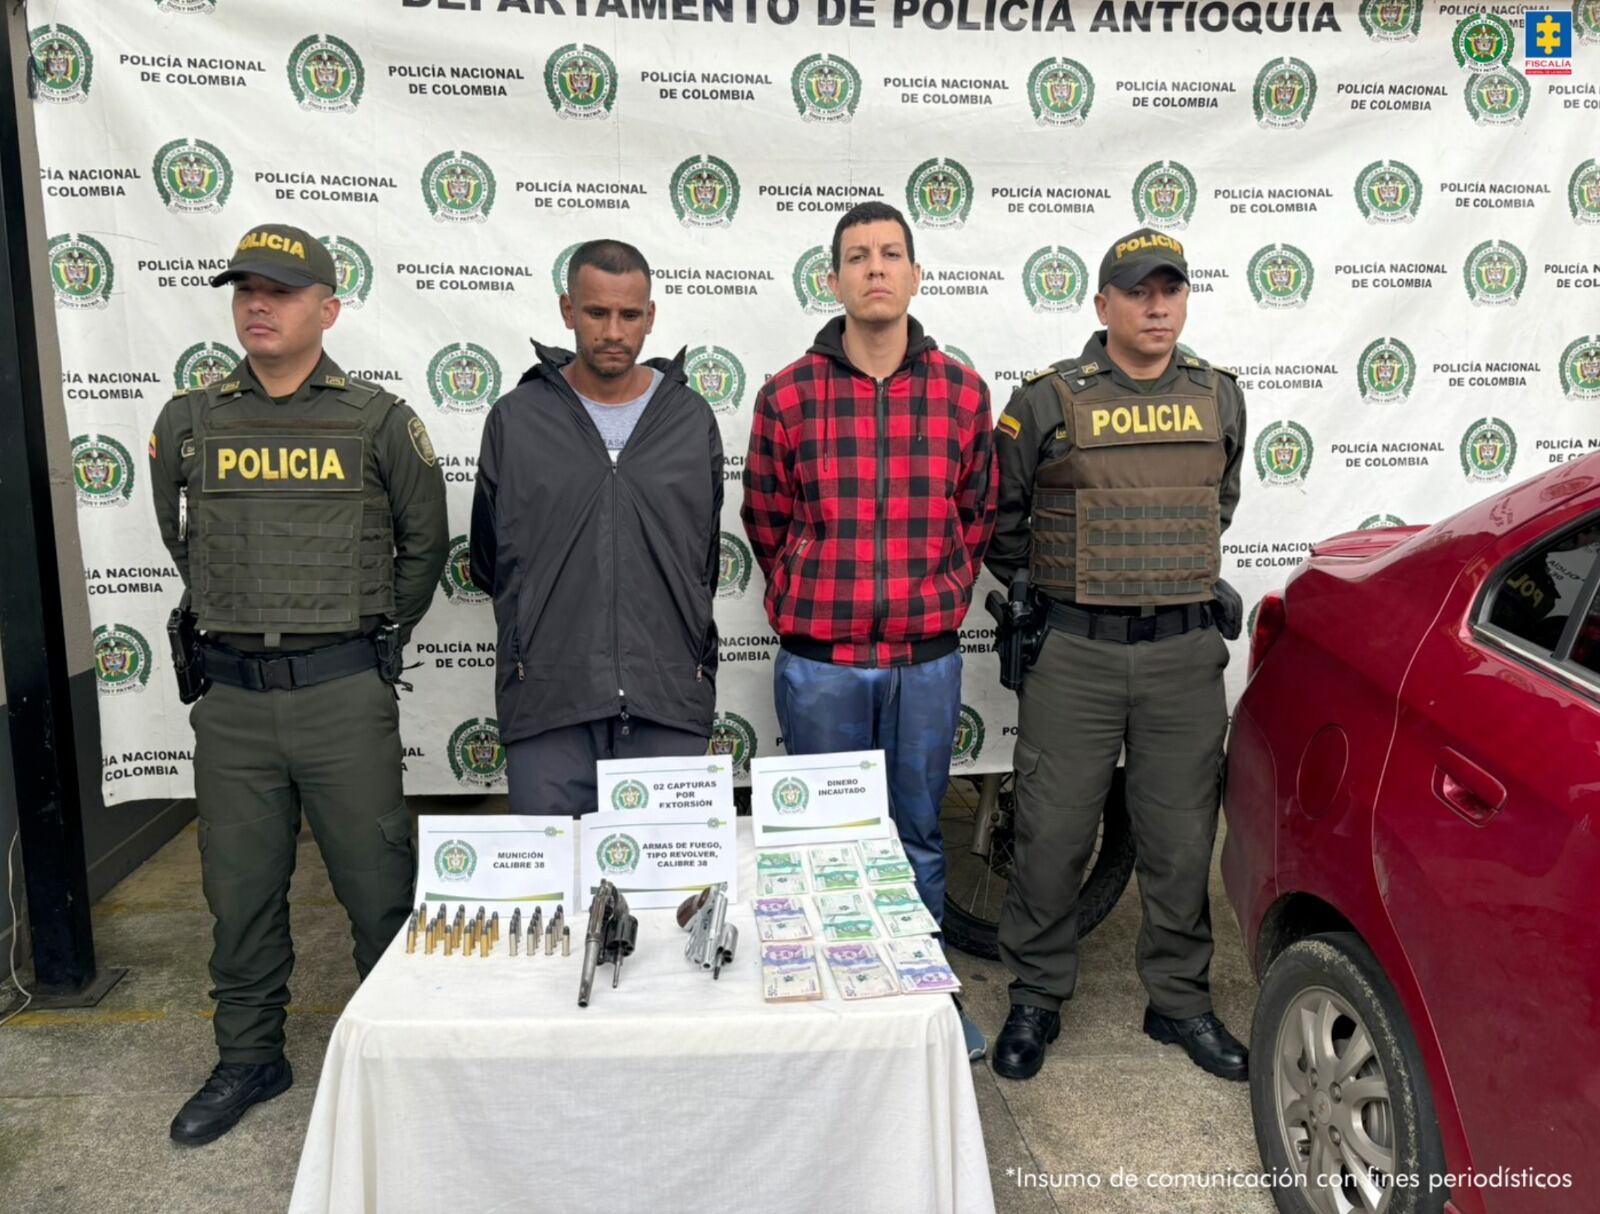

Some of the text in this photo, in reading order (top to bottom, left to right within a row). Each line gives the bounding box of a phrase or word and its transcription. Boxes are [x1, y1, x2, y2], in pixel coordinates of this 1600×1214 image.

[817, 0, 876, 28] DE
[1089, 1, 1342, 35] ANTIOQUIA
[120, 55, 265, 71] POLICÍA NACIONAL
[388, 65, 524, 79] POLICÍA NACIONAL
[641, 71, 772, 84] POLICÍA NACIONAL
[141, 72, 246, 86] DE COLOMBIA
[884, 77, 1008, 89] POLICÍA NACIONAL
[409, 84, 507, 96] DE COLOMBIA
[1116, 80, 1236, 92] POLICÍA NACIONAL
[1337, 83, 1448, 95] POLICÍA NACIONAL
[1548, 83, 1596, 95] POLICÍA
[660, 89, 754, 100] DE COLOMBIA
[902, 93, 992, 104] DE COLOMBIA
[1133, 97, 1218, 108] DE COLOMBIA
[1351, 100, 1431, 110] DE COLOMBIA
[1564, 99, 1580, 108] DE
[69, 168, 141, 180] NACIONAL
[255, 172, 397, 188] POLICÍA NACIONAL
[48, 186, 125, 197] COLOMBIA
[516, 181, 647, 194] POLICÍA NACIONAL
[759, 184, 884, 196] POLICÍA NACIONAL
[992, 186, 1111, 198] POLICÍA NACIONAL
[1441, 182, 1550, 193] POLICÍA NACIONAL
[276, 189, 379, 202] DE COLOMBIA
[1214, 188, 1333, 199] POLICÍA NACIONAL
[535, 198, 630, 209] DE COLOMBIA
[777, 202, 793, 211] DE
[1008, 203, 1094, 213] DE COLOMBIA
[1230, 203, 1317, 213] DE COLOMBIA
[1456, 198, 1534, 208] DE COLOMBIA
[1115, 233, 1183, 259] POLICIA
[138, 258, 230, 271] POLICÍA NACI
[397, 263, 532, 276] POLICÍA NACIONAL
[1335, 263, 1447, 274] POLICÍA NACIONAL
[1545, 264, 1588, 274] POLICÍA
[706, 270, 774, 280] NACIONAL
[939, 271, 1004, 280] NACIONAL
[1190, 270, 1229, 278] IONAL
[158, 277, 176, 287] DE
[416, 280, 514, 291] DE COLOMBIA
[1352, 278, 1432, 288] DE COLOMBIA
[1557, 279, 1570, 288] DE
[665, 285, 757, 295] DE COLOMBIA
[920, 285, 989, 296] COLOMBIA
[1275, 365, 1338, 374] NACIONAL
[1433, 362, 1540, 373] POLICÍA NACIONAL
[88, 373, 160, 383] NACIONAL
[349, 370, 403, 381] CIONAL
[1258, 379, 1323, 389] COLOMBIA
[1449, 377, 1526, 386] DE COLOMBIA
[67, 389, 143, 399] COLOMBIA
[1092, 404, 1203, 436] POLICIA
[1332, 442, 1444, 453] POLICÍA NACIONAL
[1536, 439, 1583, 449] POLICÍA
[217, 447, 345, 480] POLICIA
[1346, 457, 1428, 467] DE COLOMBIA
[1549, 454, 1563, 463] DE
[1223, 543, 1314, 554] POLICÍA NACION
[1237, 557, 1303, 568] DE COLOMB
[106, 567, 178, 579] NACIONAL
[88, 583, 163, 595] COLOMBIA
[959, 629, 997, 640] ACION
[719, 635, 779, 648] NACIONA
[417, 642, 472, 653] POLICÍA
[959, 643, 998, 654] OMBIA
[719, 650, 771, 662] LOMBIA
[436, 658, 495, 669] DE COLO
[105, 766, 178, 781] COLOMBIA
[667, 781, 716, 790] CAPTURAS
[819, 787, 866, 796] INCAUTADO
